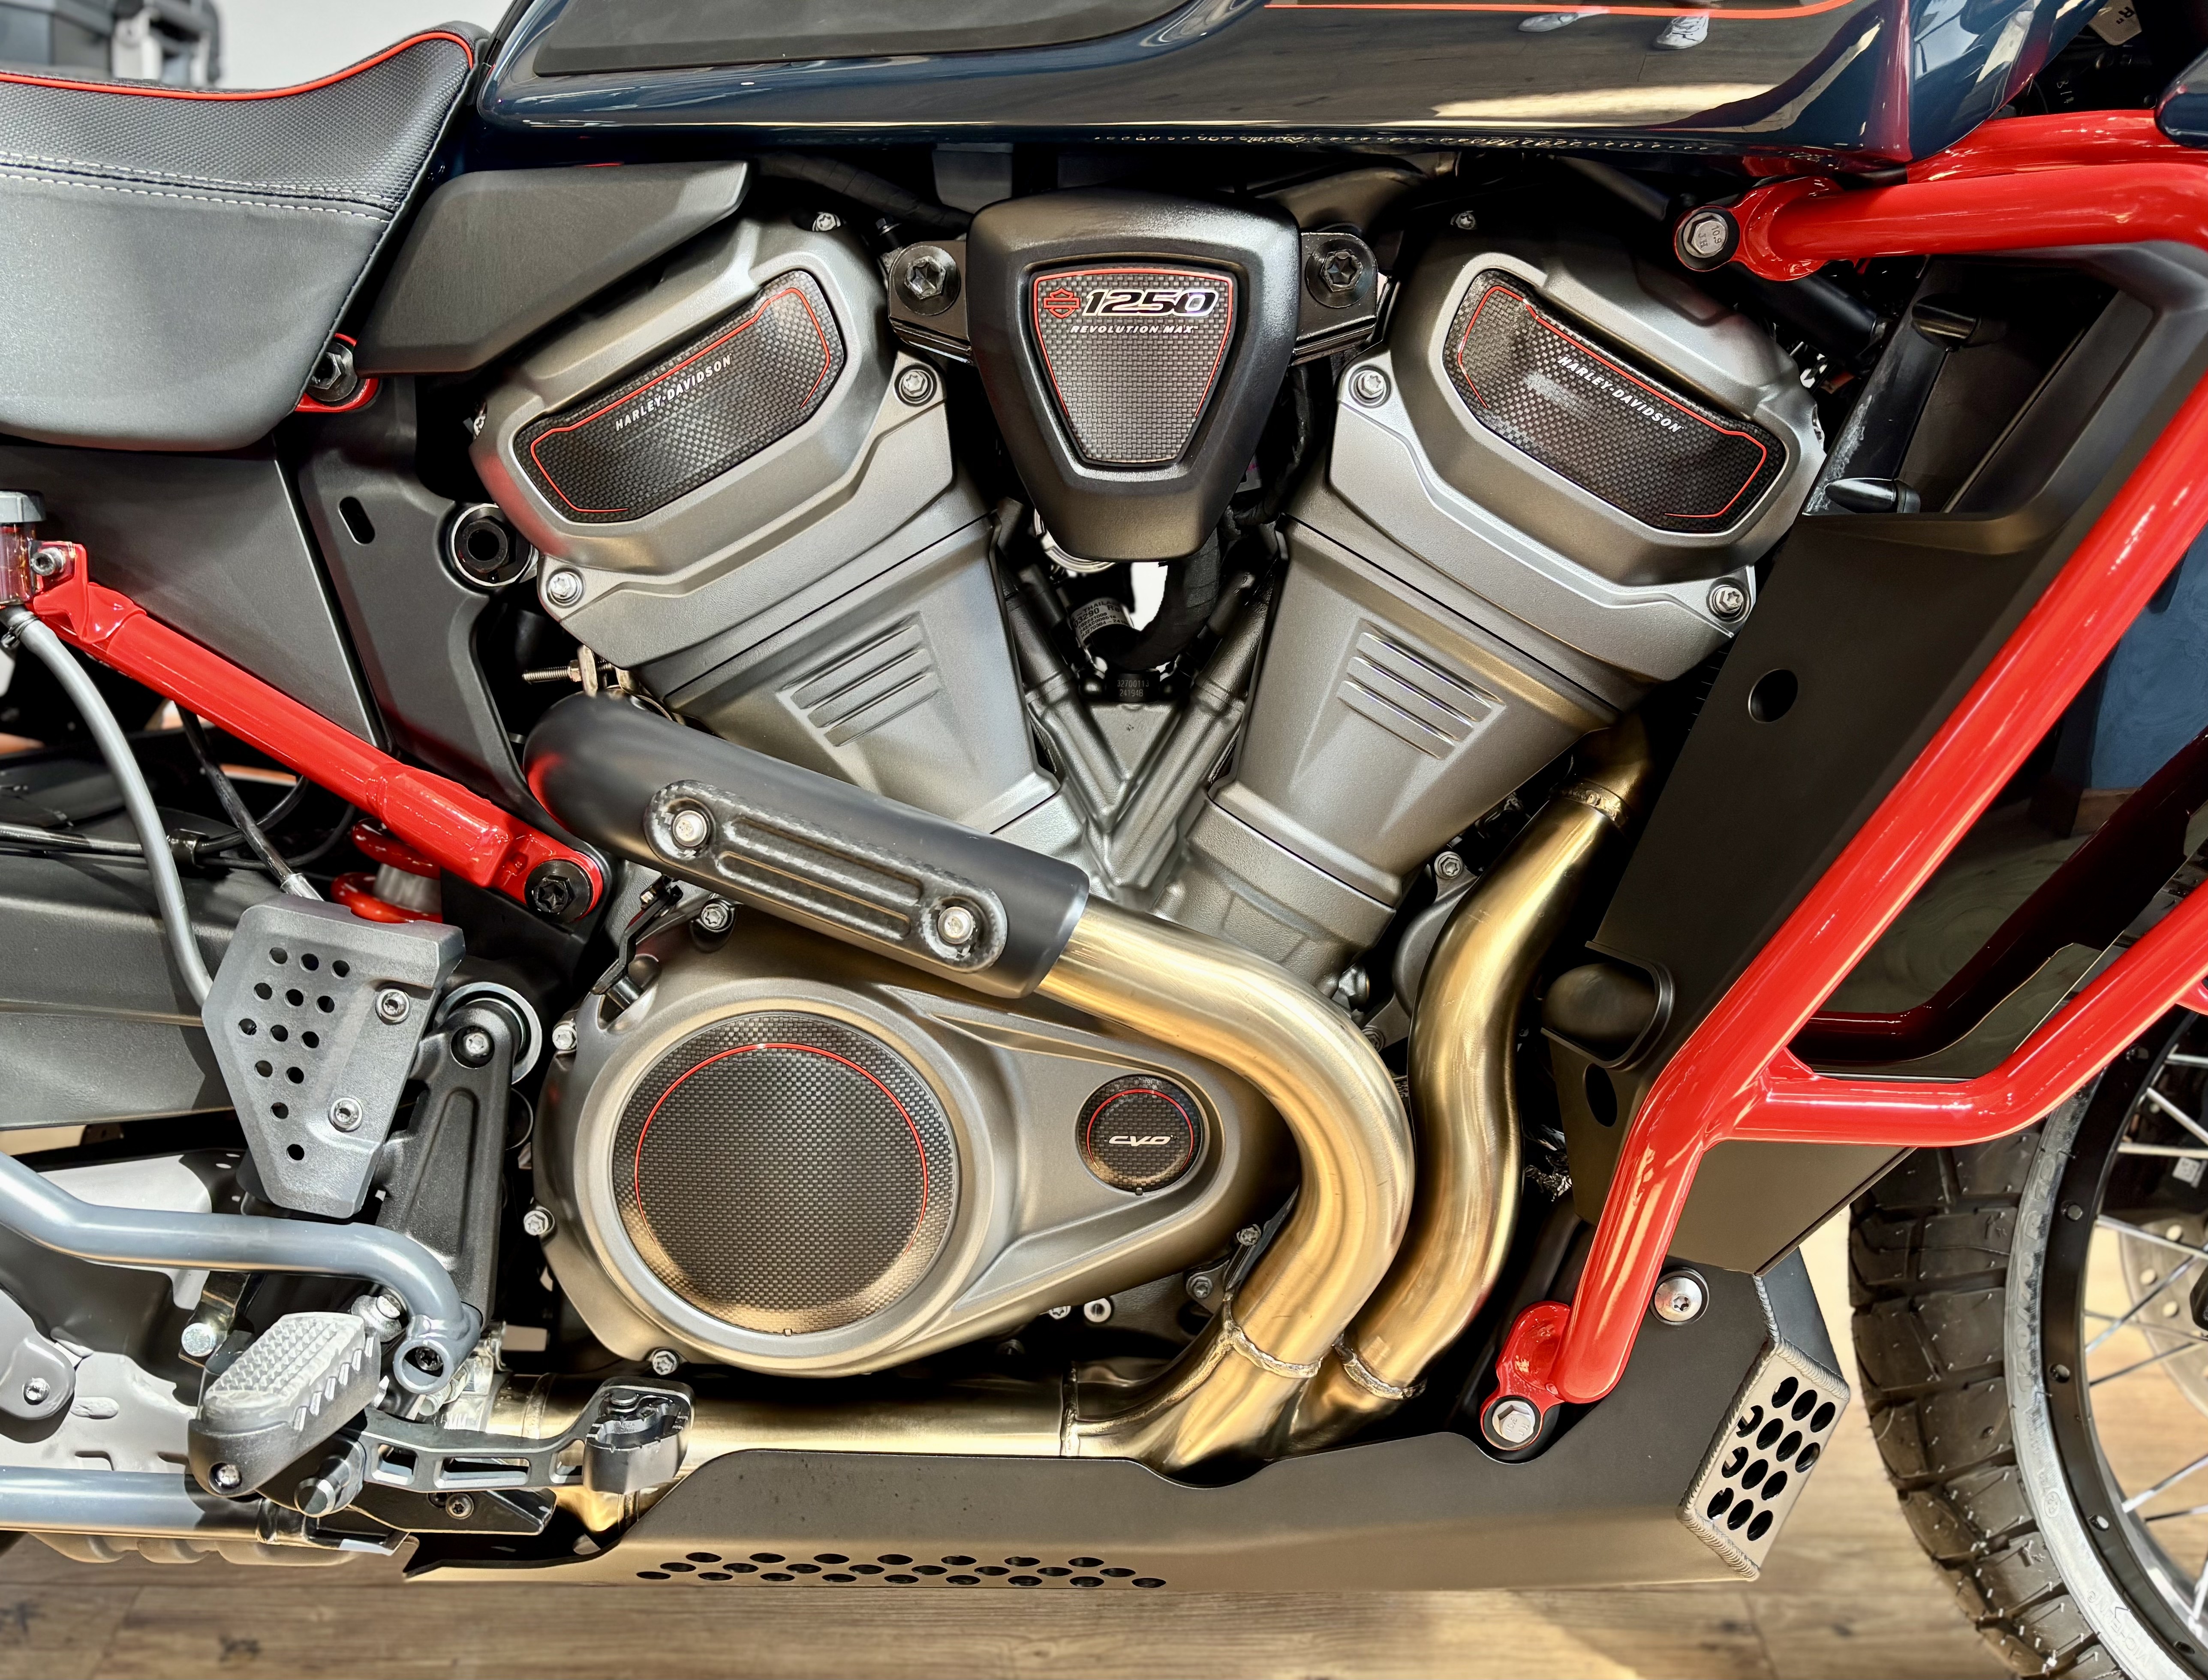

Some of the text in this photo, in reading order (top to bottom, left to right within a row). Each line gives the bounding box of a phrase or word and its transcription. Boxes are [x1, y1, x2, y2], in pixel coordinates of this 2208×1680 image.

[1712, 225, 1722, 244] 10.9
[1082, 289, 1218, 317] 1250
[1070, 325, 1159, 334] REVOLUTION
[1109, 1136, 1171, 1146] CVO
